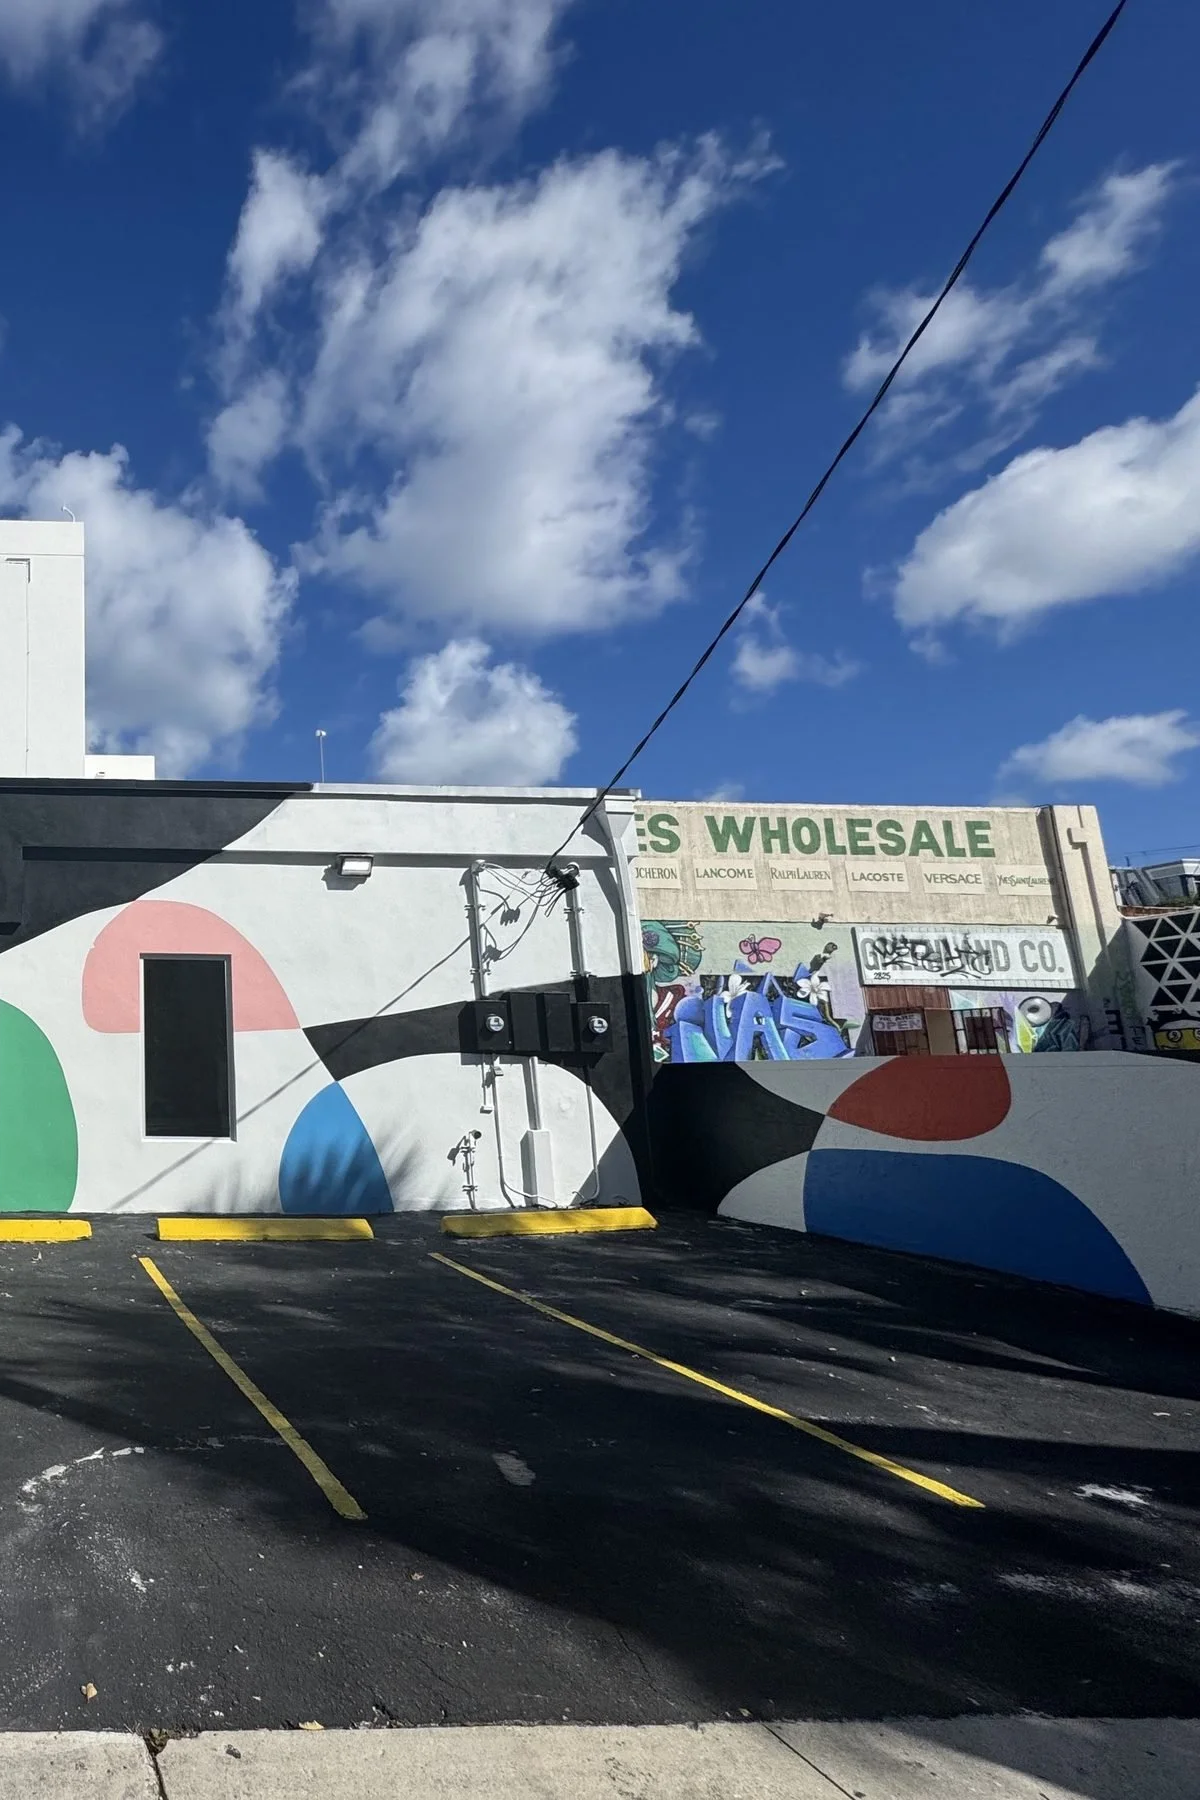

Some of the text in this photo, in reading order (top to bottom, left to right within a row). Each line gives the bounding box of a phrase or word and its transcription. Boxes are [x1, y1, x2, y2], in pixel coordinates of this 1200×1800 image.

[703, 814, 996, 858] WHOLESALE
[695, 867, 754, 879] LANCOME
[851, 871, 904, 882] LACOSTE
[923, 873, 982, 885] VERSACE
[1018, 939, 1065, 973] CO.
[875, 1019, 921, 1030] OPEN
